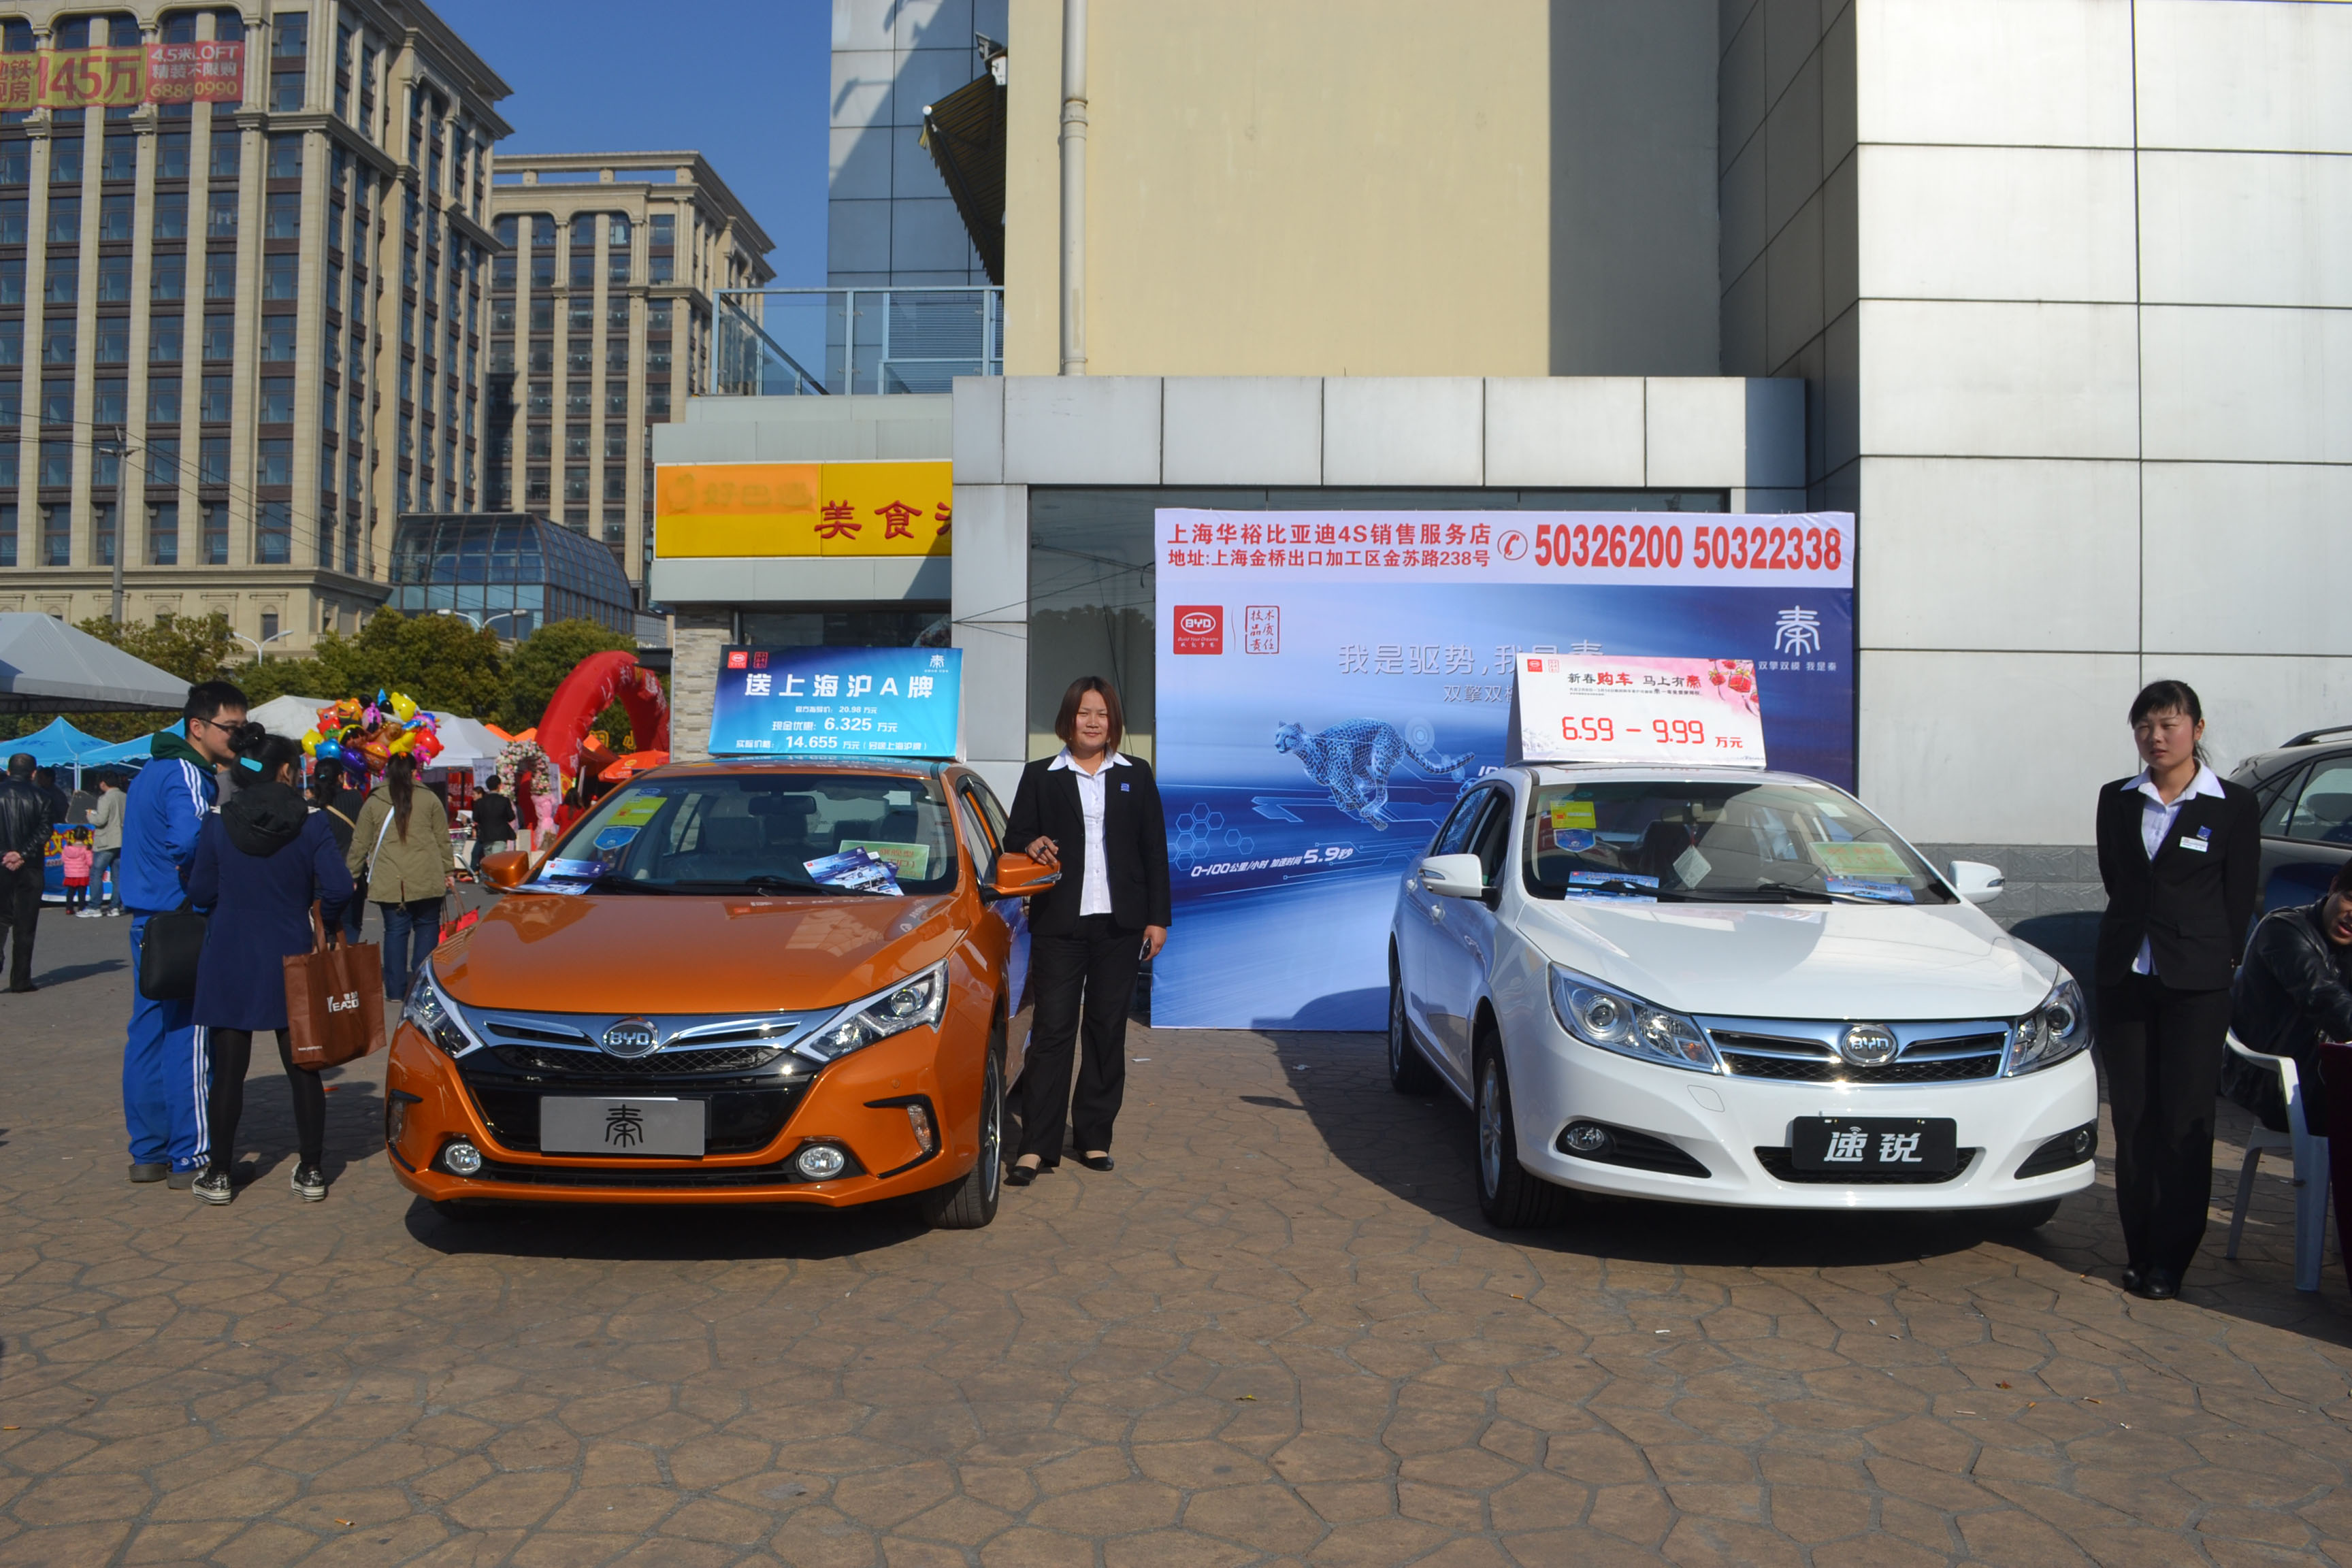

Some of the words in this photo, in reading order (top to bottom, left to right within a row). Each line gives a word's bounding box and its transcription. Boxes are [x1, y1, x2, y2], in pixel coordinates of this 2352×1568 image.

[151, 45, 238, 62] 4.5米LOFT
[32, 54, 141, 100] 145万
[152, 62, 237, 78] 精装不限购
[150, 80, 238, 98] 68860990
[1167, 523, 1491, 545] 上海华裕比亚迪4S销售服务店
[1534, 524, 1683, 568] 50326200
[1693, 525, 1842, 570] 50322338
[1168, 549, 1490, 567] 地址:上海金桥出口加工区金苏路238号
[1185, 618, 1211, 628] BYD
[1250, 609, 1275, 621] 技术
[1250, 623, 1274, 636] 品质
[1774, 605, 1821, 657] 秦
[1250, 638, 1275, 651] 责任
[745, 673, 933, 699] 送上海沪A牌
[1567, 672, 1633, 687] 新春购车
[838, 705, 861, 714] 20.98
[823, 717, 872, 732] 6.325
[877, 722, 898, 733] 万元
[1562, 716, 1614, 741] 6.59
[1652, 719, 1705, 745] 9.99
[1714, 736, 1743, 749] 万元
[785, 735, 838, 749] 14.655
[1190, 859, 1269, 877] 0-100公里/小时
[1269, 855, 1303, 868] 加速时间
[1303, 846, 1354, 864] 5.9秒
[609, 1032, 649, 1045] BYD
[1850, 1036, 1889, 1050] BYD
[605, 1104, 643, 1148] 秦
[1823, 1128, 1923, 1162] 速锐
